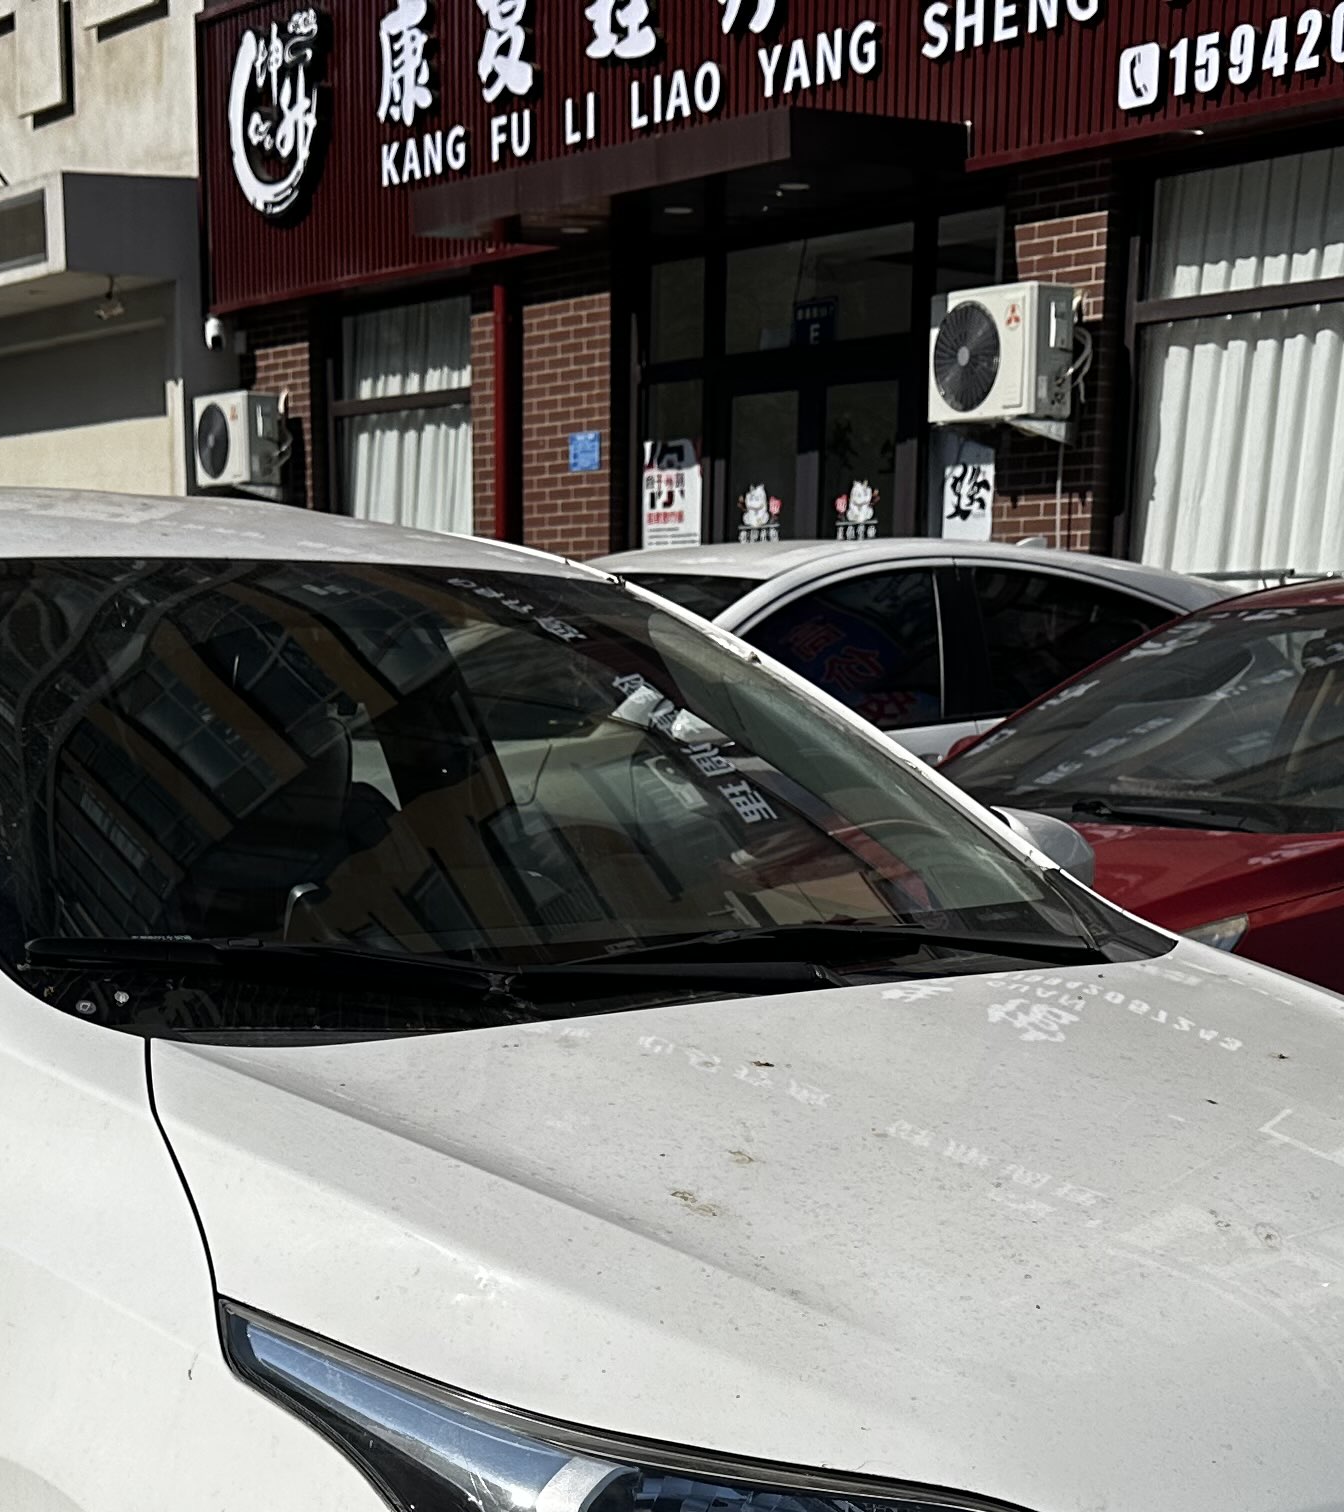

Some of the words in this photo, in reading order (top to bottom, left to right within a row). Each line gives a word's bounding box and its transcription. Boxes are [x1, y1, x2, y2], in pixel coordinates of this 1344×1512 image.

[377, 0, 776, 127] 康复
[381, 125, 466, 188] KANG
[491, 108, 531, 163] FU
[565, 91, 596, 146] LI
[630, 61, 721, 131] LIAO
[757, 19, 879, 99] YANG
